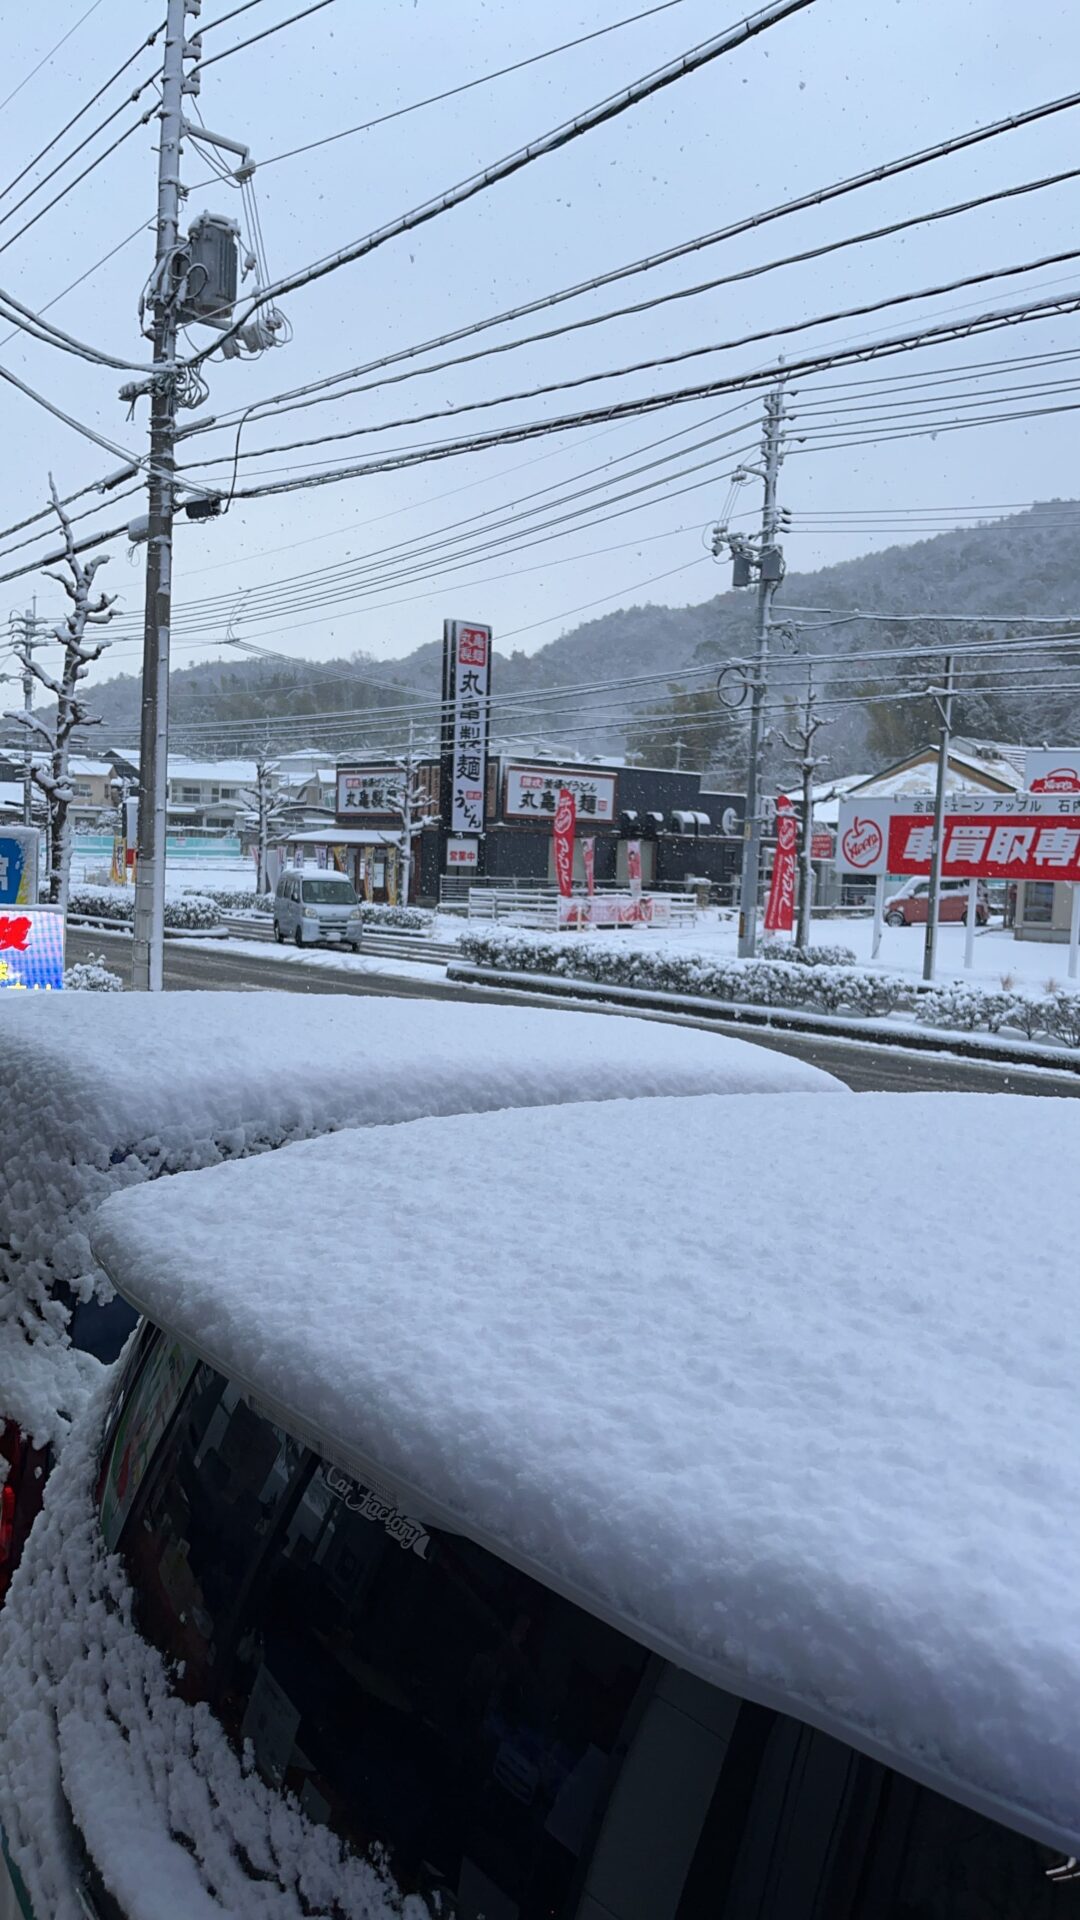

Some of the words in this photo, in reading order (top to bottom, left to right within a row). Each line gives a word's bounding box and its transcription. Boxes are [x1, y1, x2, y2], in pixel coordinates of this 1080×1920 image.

[457, 669, 484, 783] 丸亀製麺
[454, 789, 482, 829] うどん
[518, 790, 598, 815] 丸亀麺
[992, 800, 1042, 813] アップル
[449, 850, 476, 862] 営業中
[902, 825, 1080, 868] 車買取専
[345, 1484, 421, 1550] Factory
